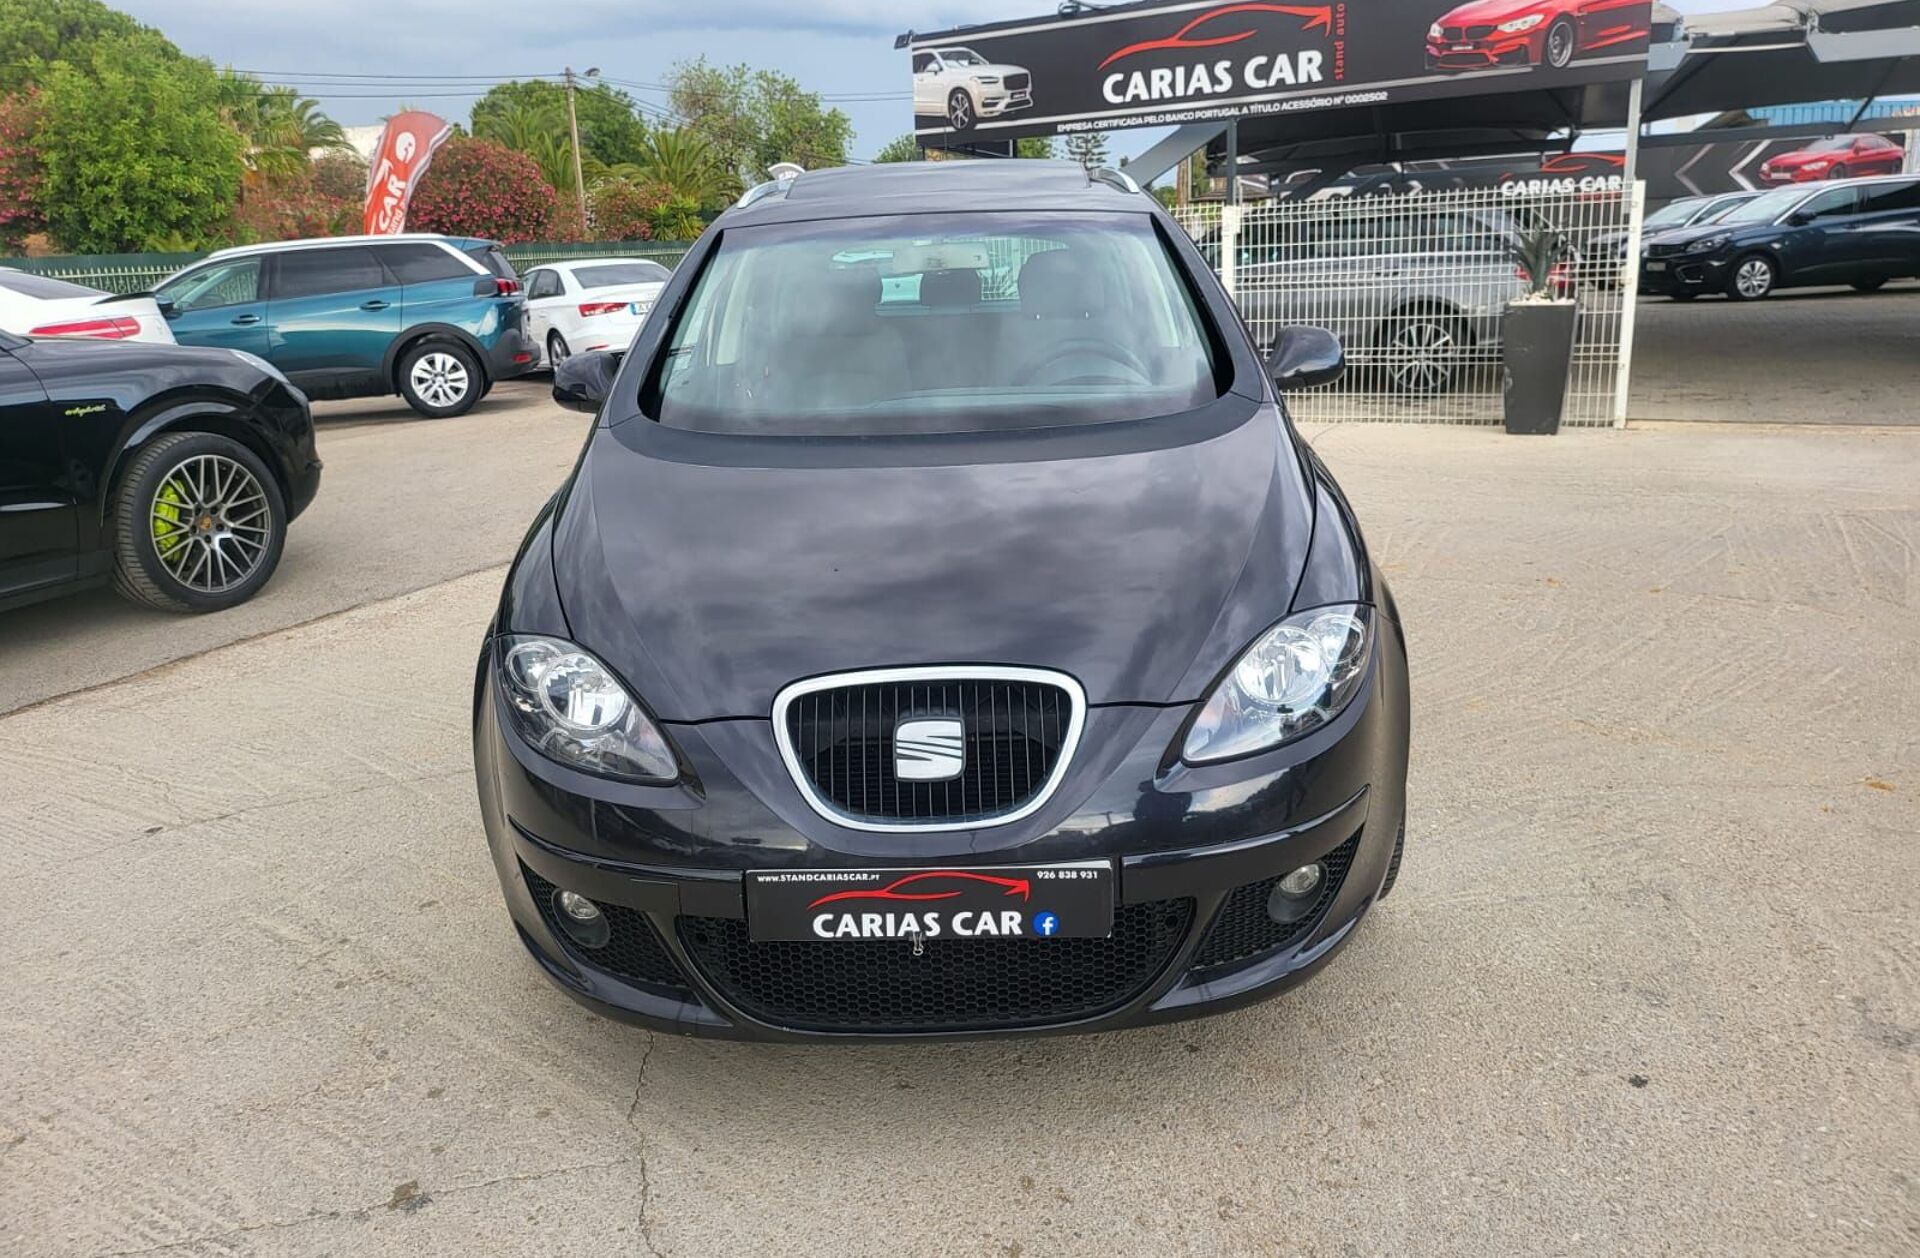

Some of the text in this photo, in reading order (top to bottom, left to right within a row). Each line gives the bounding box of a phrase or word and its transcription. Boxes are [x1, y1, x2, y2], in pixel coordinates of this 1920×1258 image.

[1334, 3, 1345, 80] stand auto
[1102, 50, 1323, 104] CARIAS CAR
[1057, 122, 1092, 133] EMPRESA
[1093, 117, 1143, 130] CERTIFICADA
[1144, 114, 1164, 125] PELO
[1165, 111, 1194, 122] BANCO
[1195, 106, 1240, 119] PORTUGAL
[1240, 105, 1249, 115] A
[1501, 174, 1622, 196] CARIAS CAR
[379, 174, 407, 231] CAR
[1037, 870, 1056, 879] 926
[1080, 870, 1098, 879] 931
[812, 910, 1023, 938] CARIAS CAR
